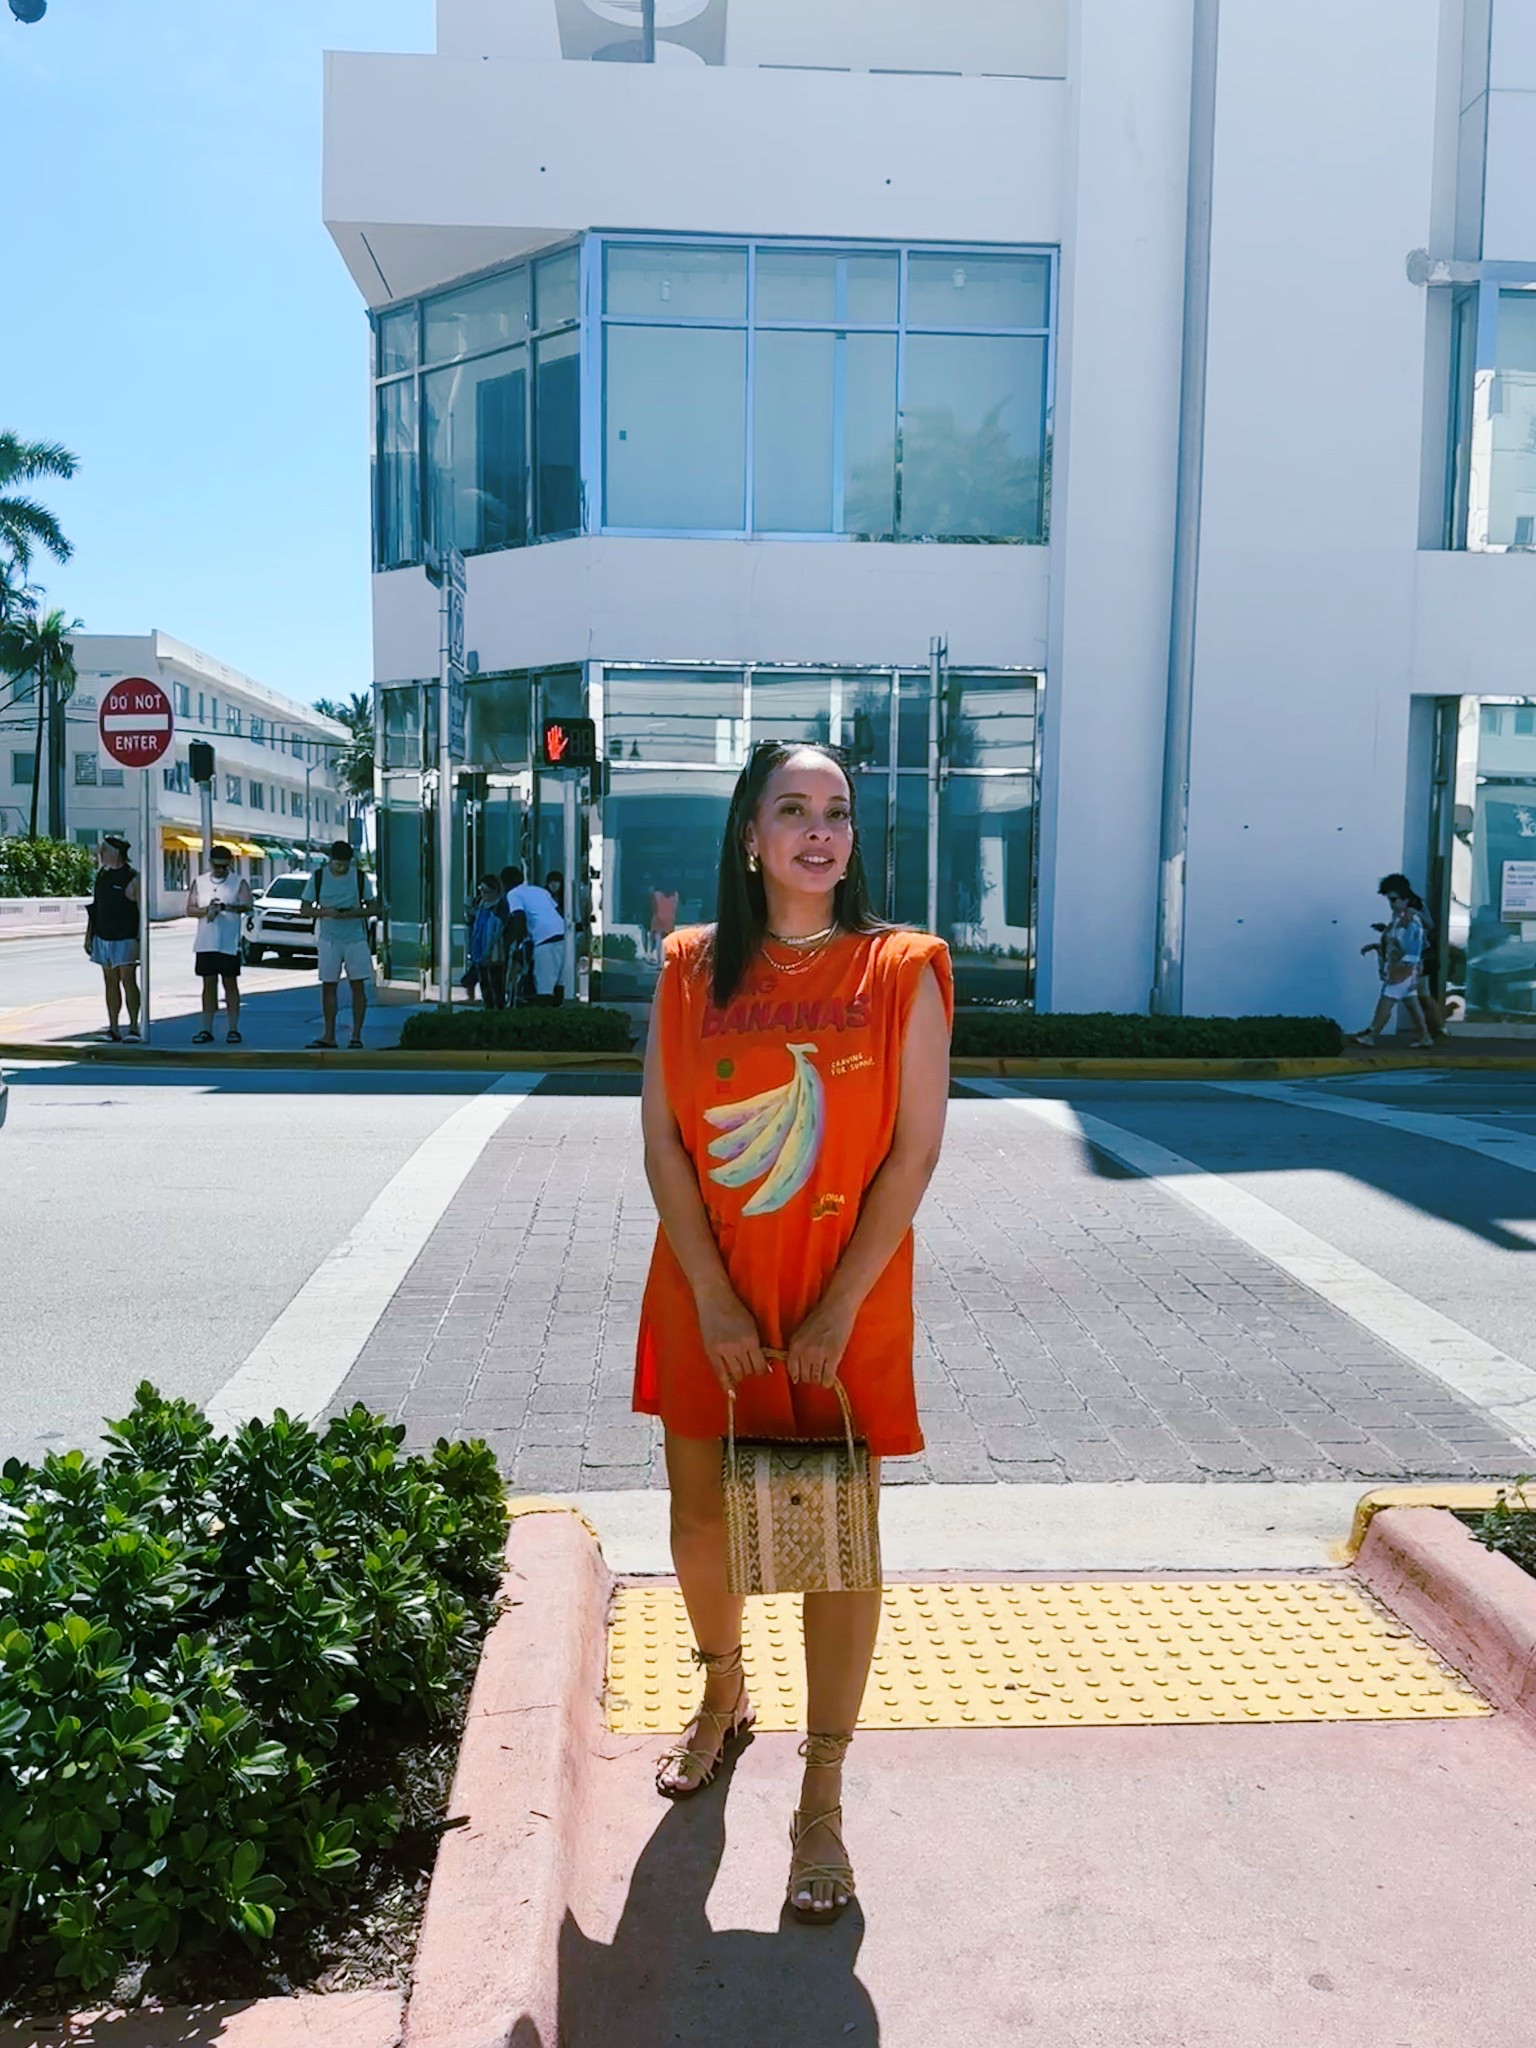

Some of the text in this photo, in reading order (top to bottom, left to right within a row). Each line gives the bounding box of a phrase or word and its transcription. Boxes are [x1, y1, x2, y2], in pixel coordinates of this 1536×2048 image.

[110, 694, 162, 710] DO NOT
[115, 735, 158, 751] ENTER
[701, 993, 871, 1039] BANANAS
